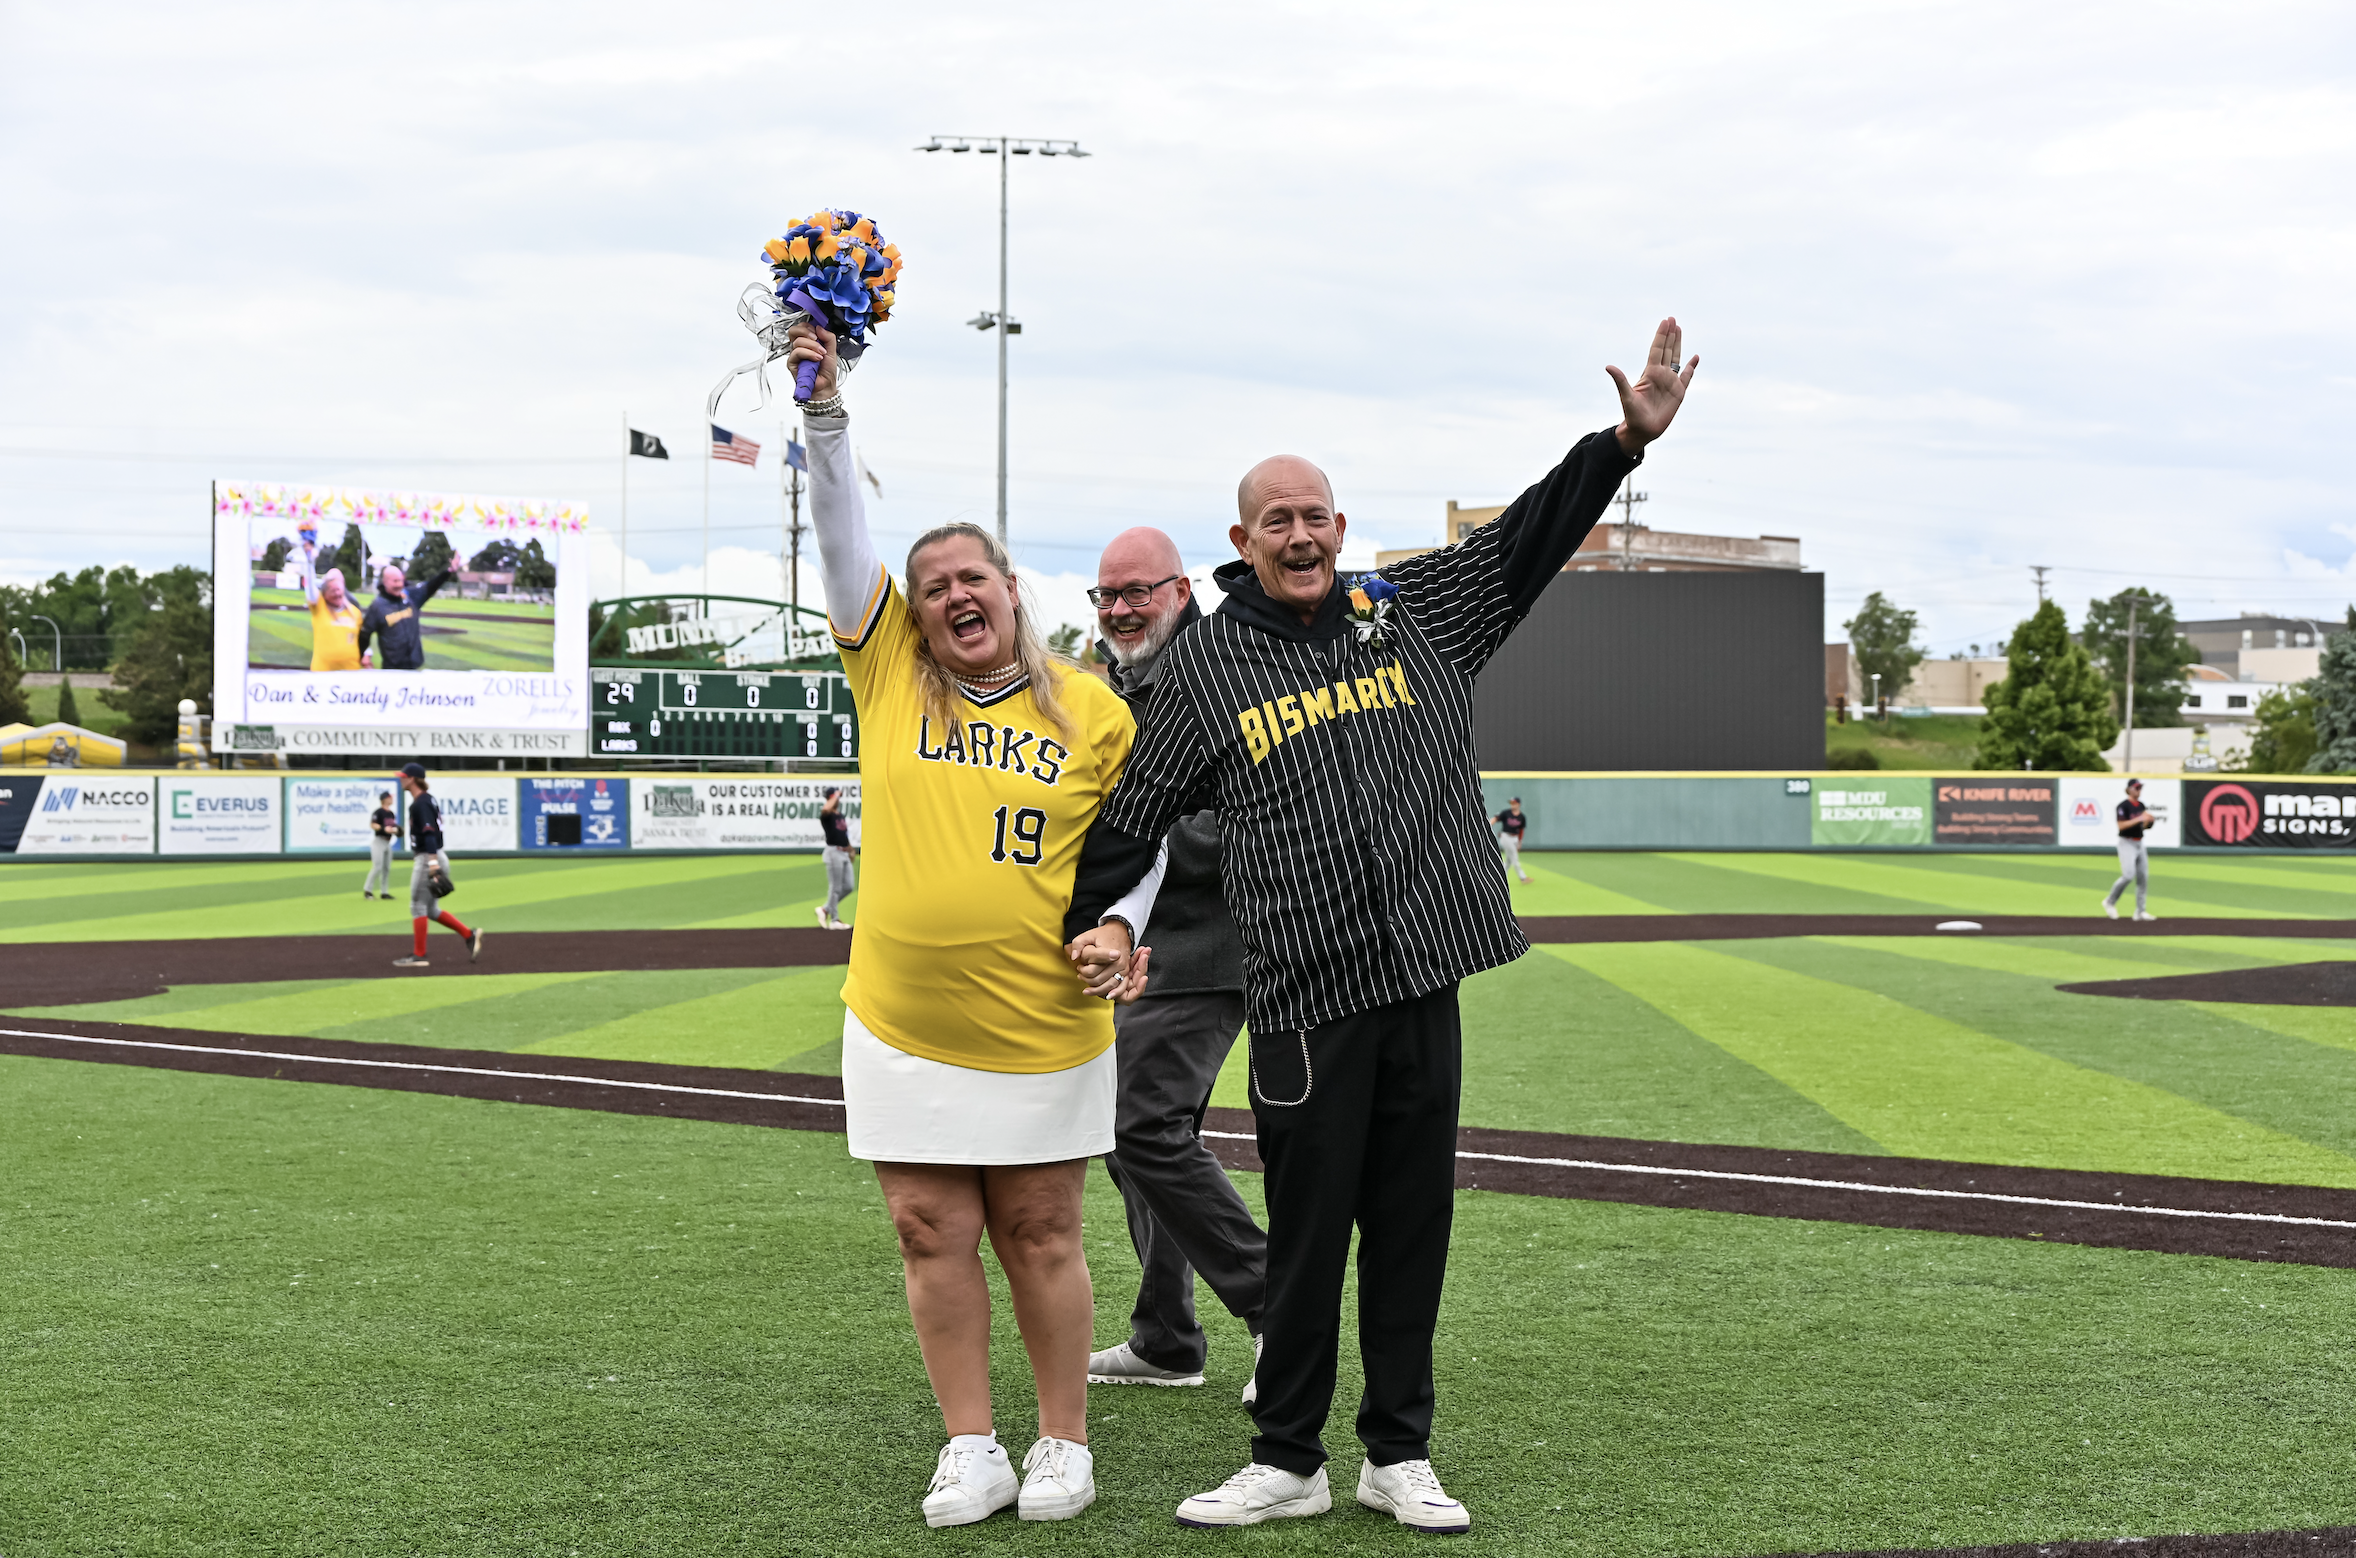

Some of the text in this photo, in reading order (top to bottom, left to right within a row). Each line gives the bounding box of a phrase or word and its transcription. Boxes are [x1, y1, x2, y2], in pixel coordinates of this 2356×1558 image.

[790, 635, 839, 659] PAR
[482, 677, 573, 698] ZORELLS
[677, 674, 702, 686] BALL
[736, 674, 770, 687] STRIKE
[802, 676, 821, 688] OUT
[248, 683, 475, 712] Dan & Sandy Johnson
[607, 682, 634, 704] 29
[683, 684, 697, 706] 0
[747, 686, 760, 708] 0
[806, 687, 819, 709] 0
[1238, 657, 1416, 766] BISMARCK
[650, 719, 661, 737] 0
[807, 722, 817, 739] 0
[841, 723, 852, 740] 0
[293, 730, 420, 748] COMMUNITY
[431, 732, 485, 749] BANK
[489, 733, 504, 749] &
[509, 733, 570, 750] TRUST
[807, 740, 817, 757] 0
[841, 740, 852, 757] 0
[913, 713, 1073, 788] LARKS
[83, 791, 149, 805] NACCO
[297, 785, 331, 798] Make
[335, 789, 342, 798] a
[345, 785, 370, 800] play
[709, 785, 861, 798] OUR CUSTOMER SEVIC
[1848, 791, 1887, 806] MDU
[1963, 787, 2052, 802] KNIFE RIVER
[196, 797, 269, 811] EVERUS
[296, 801, 368, 817] your health.
[440, 798, 508, 815] IMAGE
[642, 788, 705, 816] Dakota
[712, 802, 861, 819] IS A REAL HOMEUN
[448, 816, 509, 828] RINTING
[1820, 806, 1923, 821] RESOURCES
[989, 804, 1049, 867] 19
[2263, 818, 2350, 836] SIGNS,
